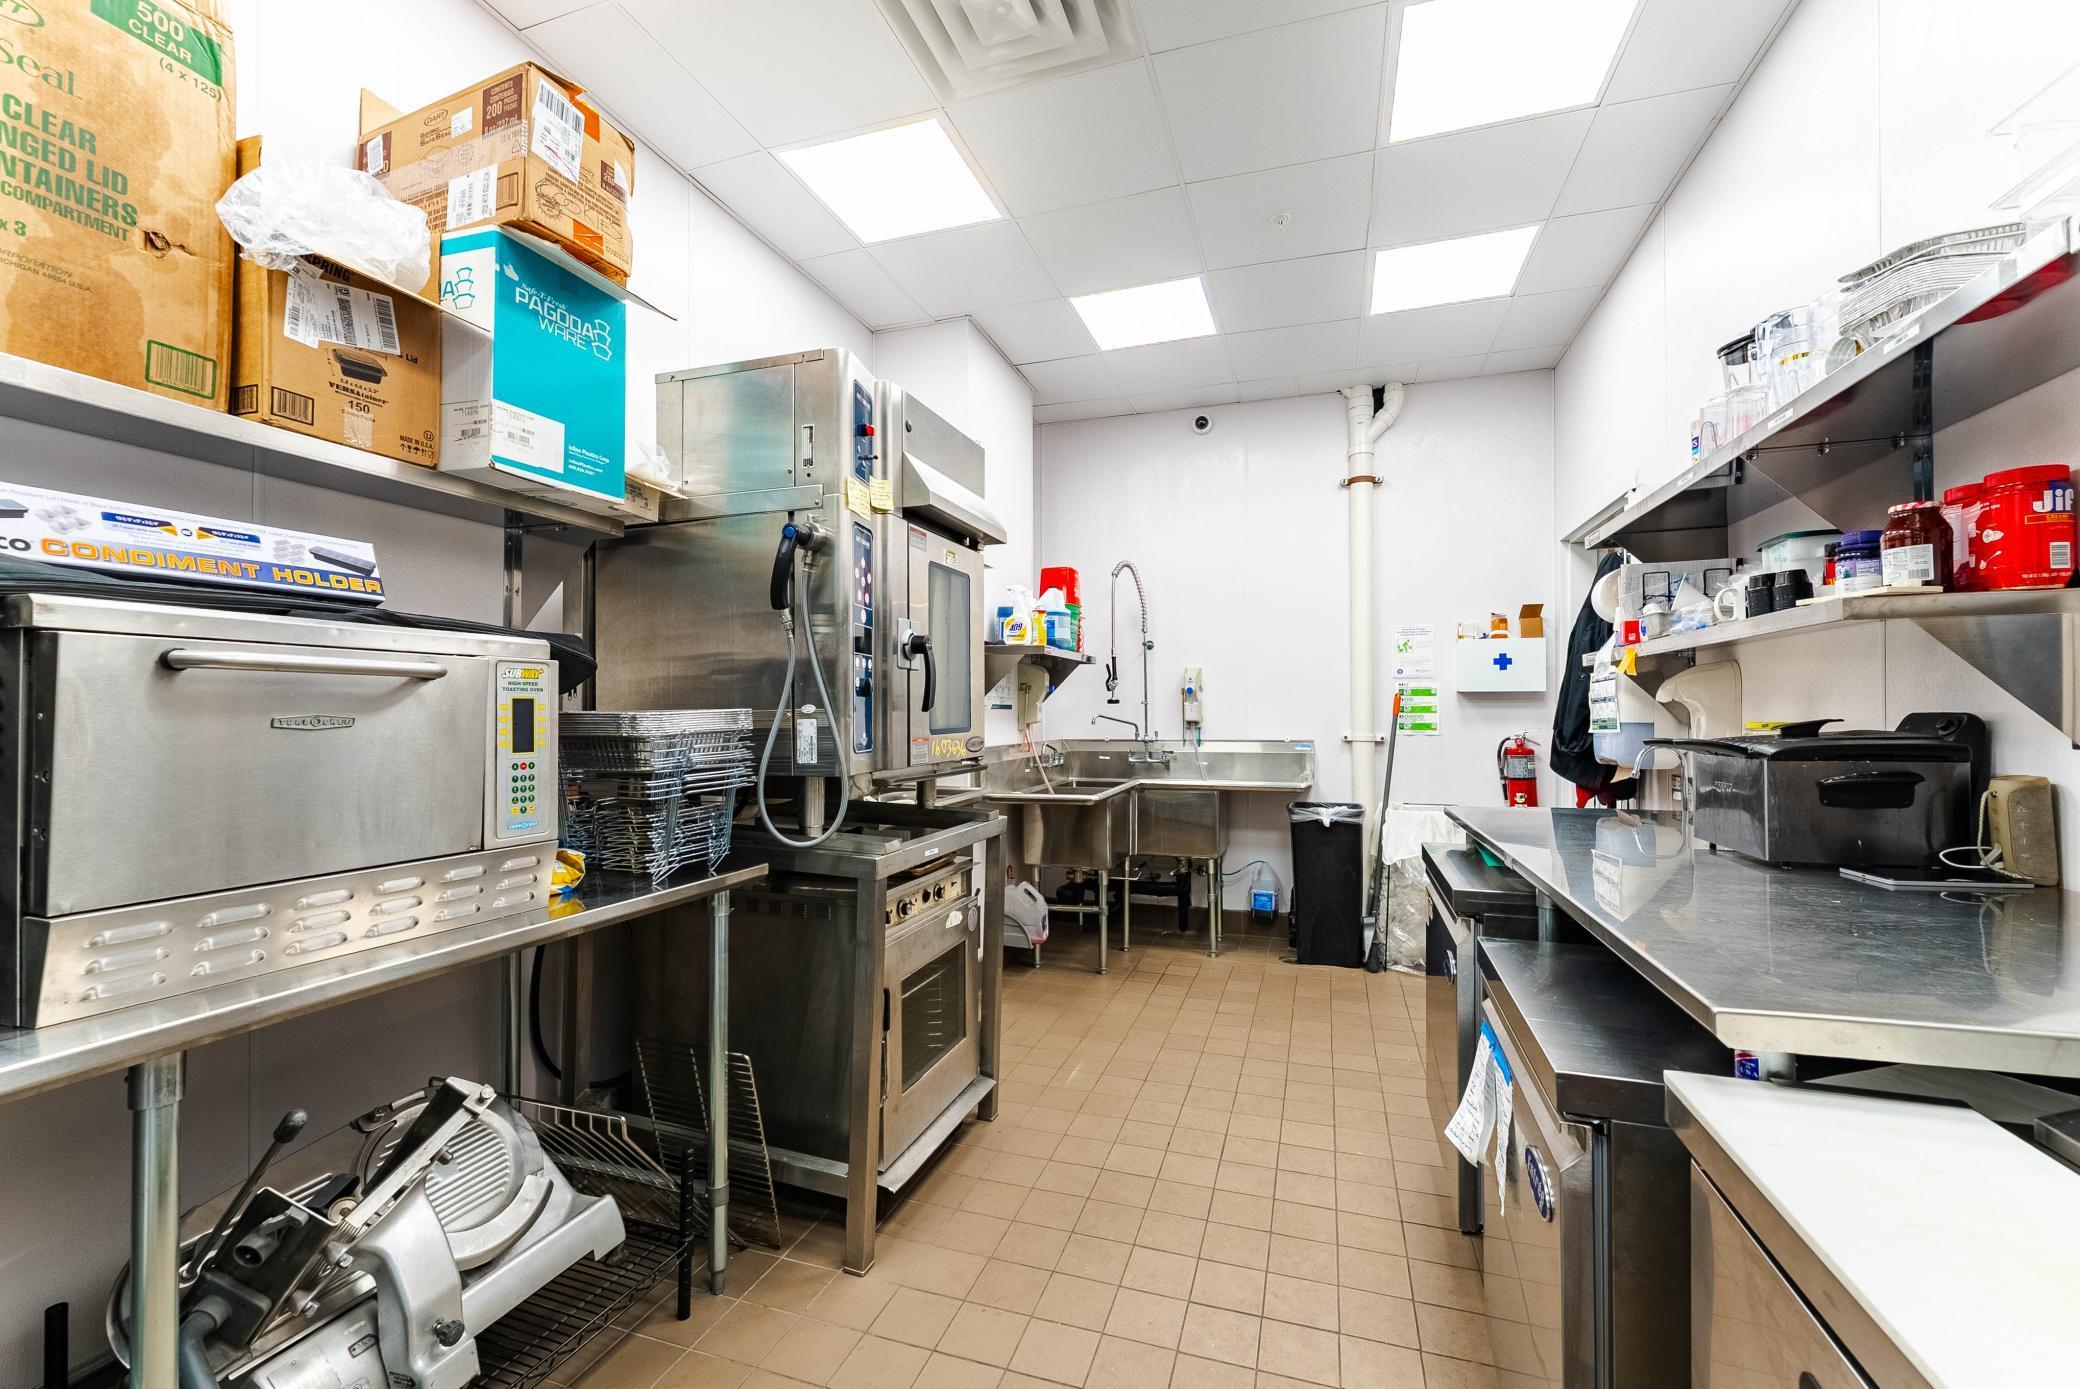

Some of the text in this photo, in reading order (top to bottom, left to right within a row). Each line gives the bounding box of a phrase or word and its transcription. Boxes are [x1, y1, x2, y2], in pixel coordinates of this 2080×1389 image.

[137, 0, 185, 42] 500
[128, 19, 191, 64] CLEAR
[160, 57, 174, 73] (4
[193, 78, 222, 102] 125)
[2, 93, 97, 156] CLEAR
[486, 101, 503, 119] 200
[86, 159, 128, 196] LID
[0, 180, 129, 241] COMPARTMENT
[14, 221, 26, 237] 3
[515, 287, 595, 341] PAGODA
[538, 315, 587, 350] WARE
[348, 400, 370, 415] 150
[2032, 488, 2075, 512] Jif
[40, 538, 260, 578] CONDIMENT
[272, 567, 382, 594] HOLDER
[1009, 622, 1023, 632] 409
[502, 668, 544, 679] SUBWAY
